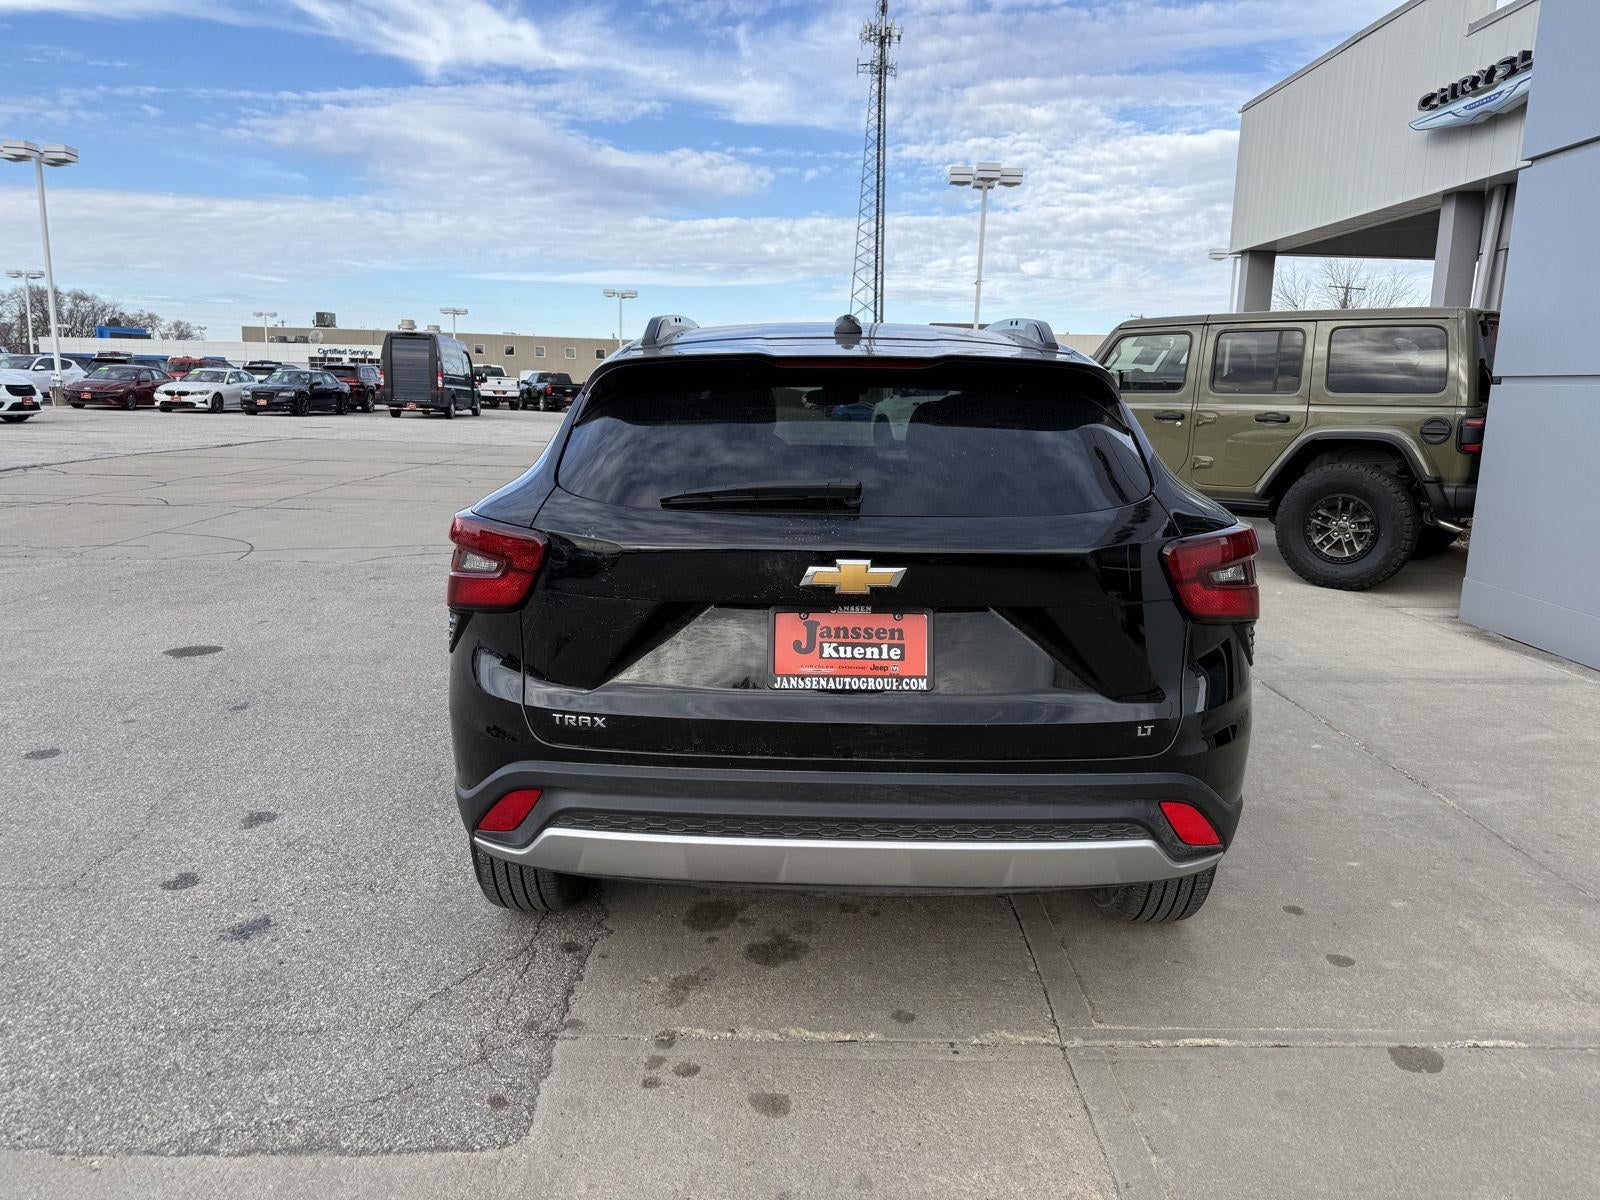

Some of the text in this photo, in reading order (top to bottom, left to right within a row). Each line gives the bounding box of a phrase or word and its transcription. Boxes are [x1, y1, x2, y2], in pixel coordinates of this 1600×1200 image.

[1417, 50, 1534, 112] CHRYSL
[317, 347, 374, 356] Certified Service
[792, 620, 905, 655] Janssen
[821, 642, 901, 660] Kuenle
[869, 664, 889, 673] Jeep
[774, 676, 928, 690] JANSSENAUTOGROUP.COM
[552, 713, 607, 728] TRAX
[1137, 725, 1155, 737] LT
